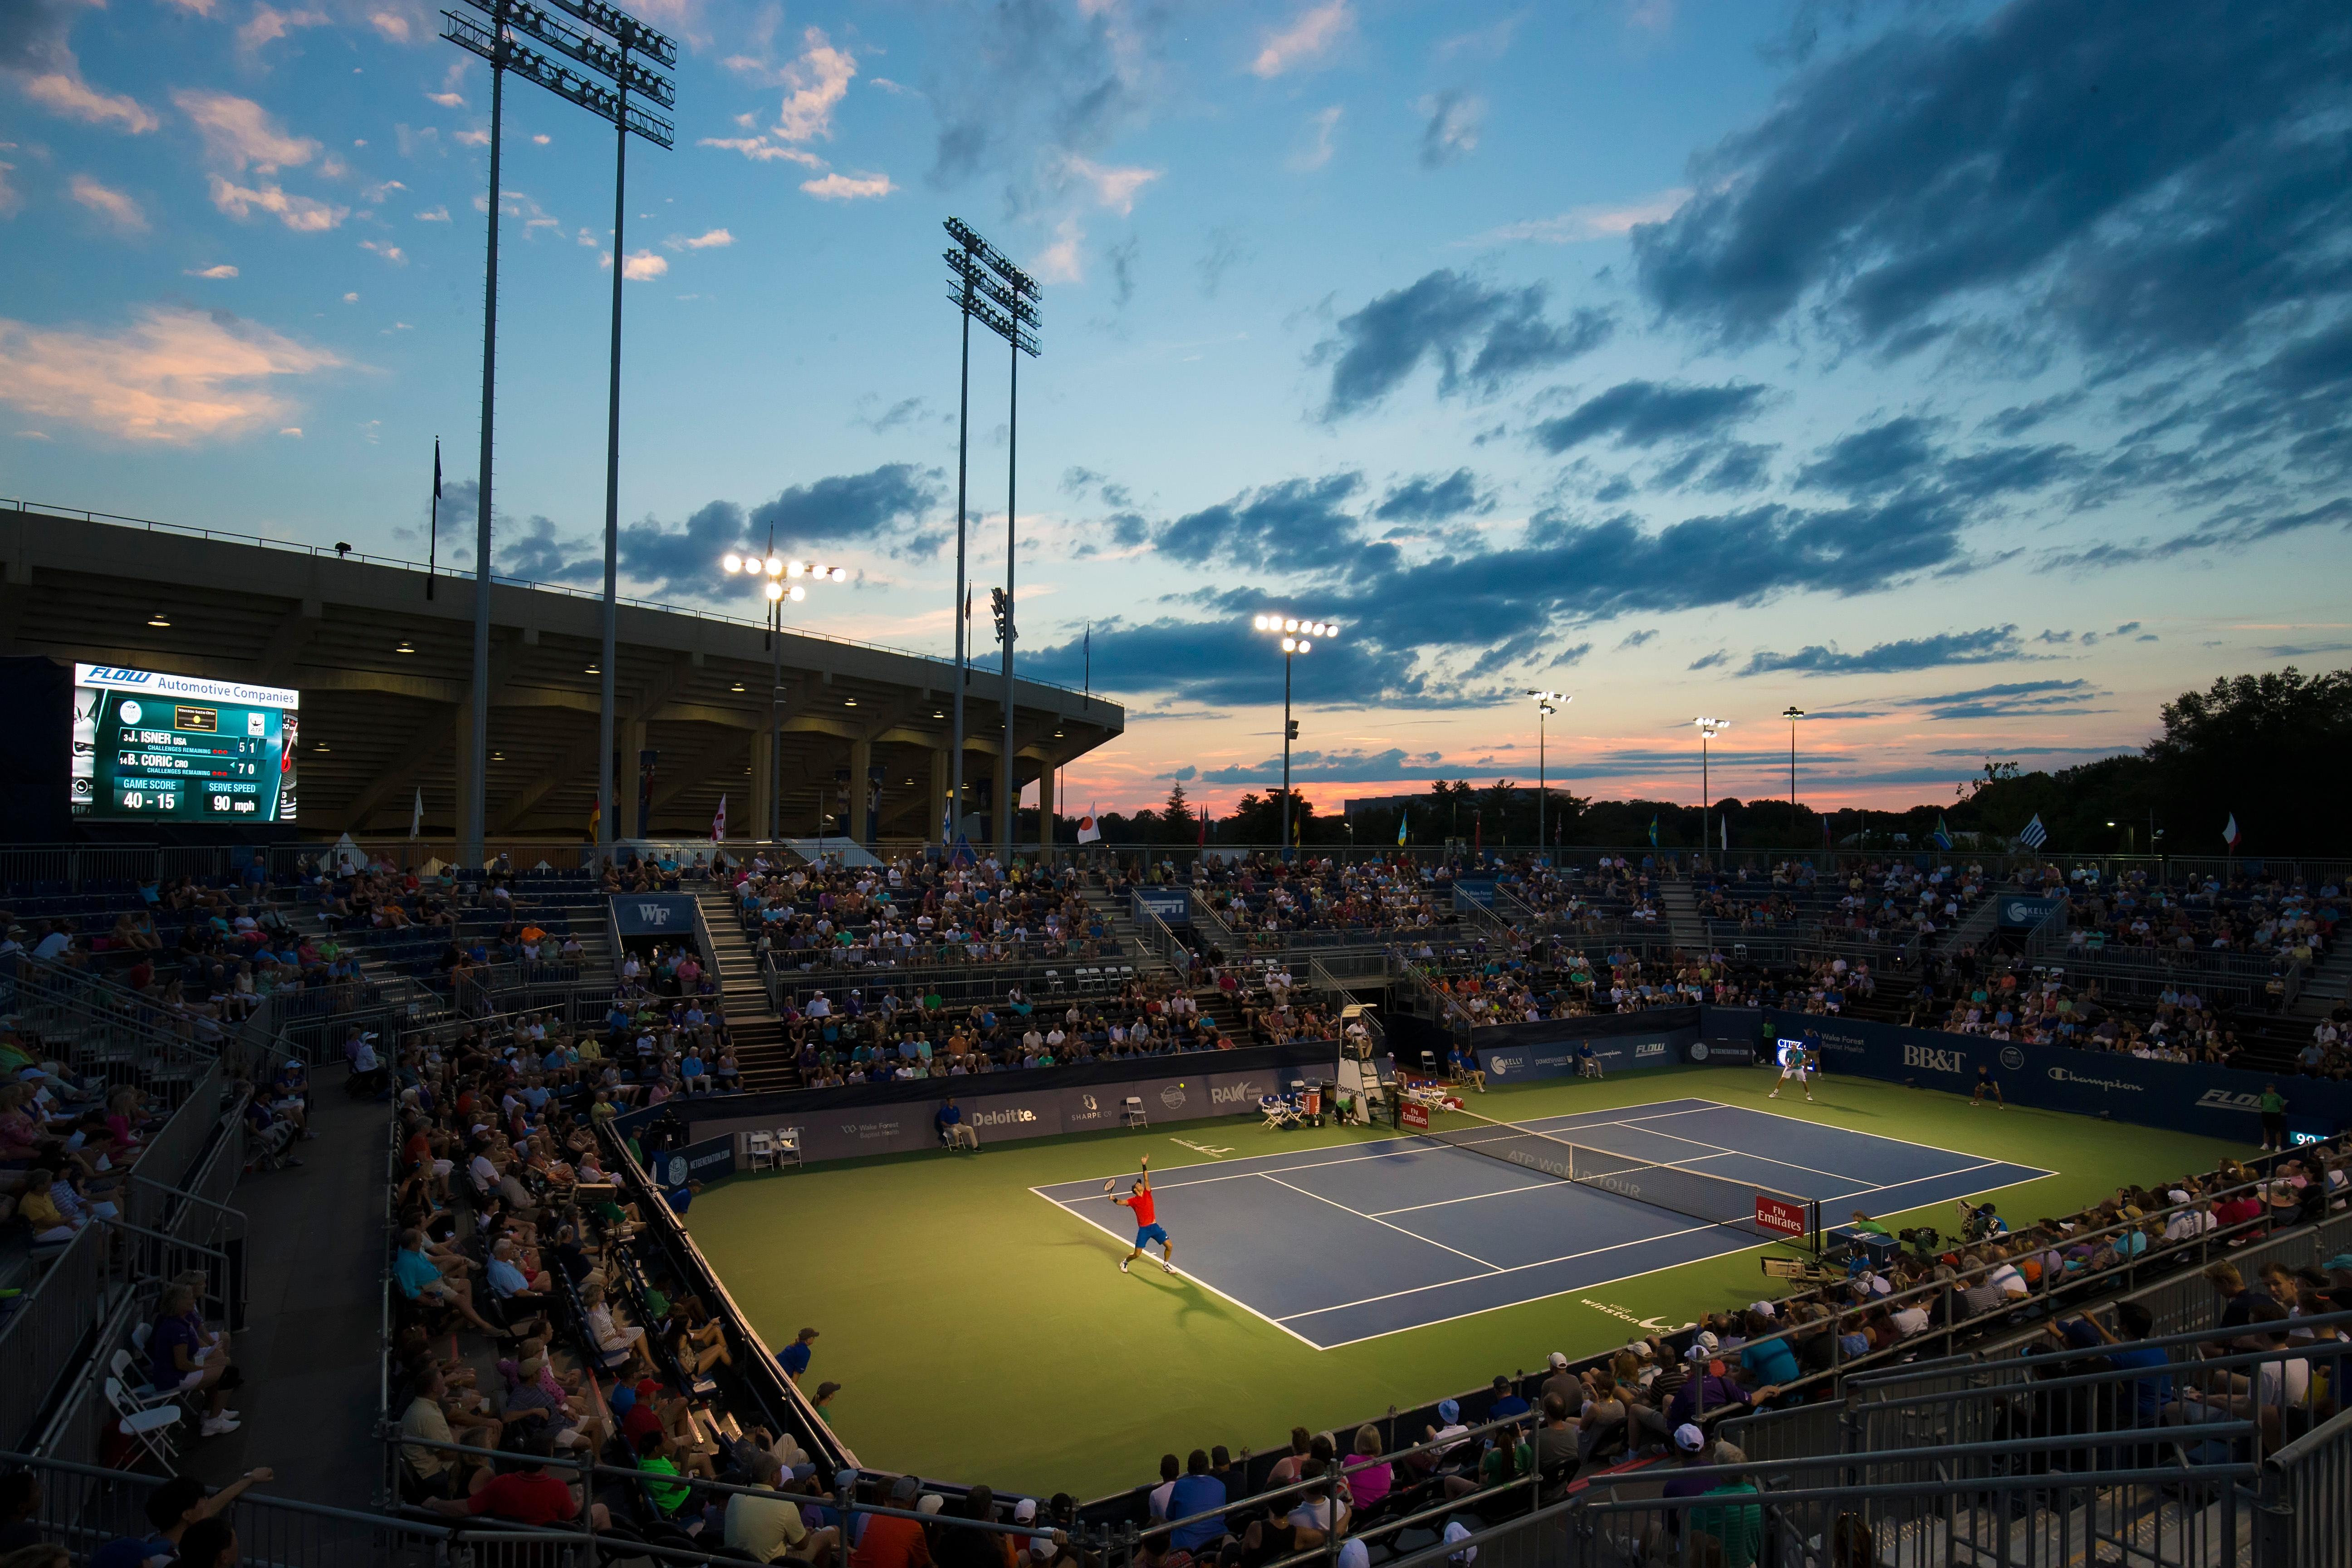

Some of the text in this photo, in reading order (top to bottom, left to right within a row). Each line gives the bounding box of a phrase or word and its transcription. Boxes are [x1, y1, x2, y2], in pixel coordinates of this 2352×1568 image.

[88, 667, 152, 683] FLOW
[158, 677, 294, 703] Automotive Companies
[141, 731, 171, 744] ISNER
[173, 737, 186, 745] USA
[239, 742, 254, 753] 5 1
[141, 754, 172, 767] CORIC
[175, 760, 188, 768] CRO
[238, 764, 255, 774] 7 0
[123, 779, 176, 790] GAME SCORE
[209, 783, 255, 793] SERVE SPEED
[123, 792, 143, 808] 40
[157, 793, 175, 809] 15
[214, 796, 255, 813] 90 mph
[1140, 900, 1184, 914] ESPN
[638, 904, 670, 925] WF
[1822, 1033, 1864, 1045] Wake Forest
[1592, 1050, 1622, 1058] hampion
[1636, 1043, 1665, 1053] FLOW
[1822, 1041, 1865, 1054] Baptist Health
[1504, 1057, 1523, 1066] KELLY
[1903, 1044, 1966, 1073] BB&T
[2048, 1067, 2144, 1092] Champion
[1338, 1084, 1362, 1097] Spectrum
[972, 1108, 1036, 1126] Deloitte.
[1072, 1112, 1102, 1121] SHARPE
[1403, 1112, 1427, 1125] Emirates
[690, 1149, 730, 1170] NETGENERATION.COM
[1508, 1150, 1534, 1164] ATP
[1599, 1176, 1641, 1198] TOUR
[1773, 1205, 1786, 1217] Fly
[1758, 1210, 1801, 1231] Emirates
[1581, 1298, 1639, 1323] winston
[1610, 1303, 1633, 1313] visit
